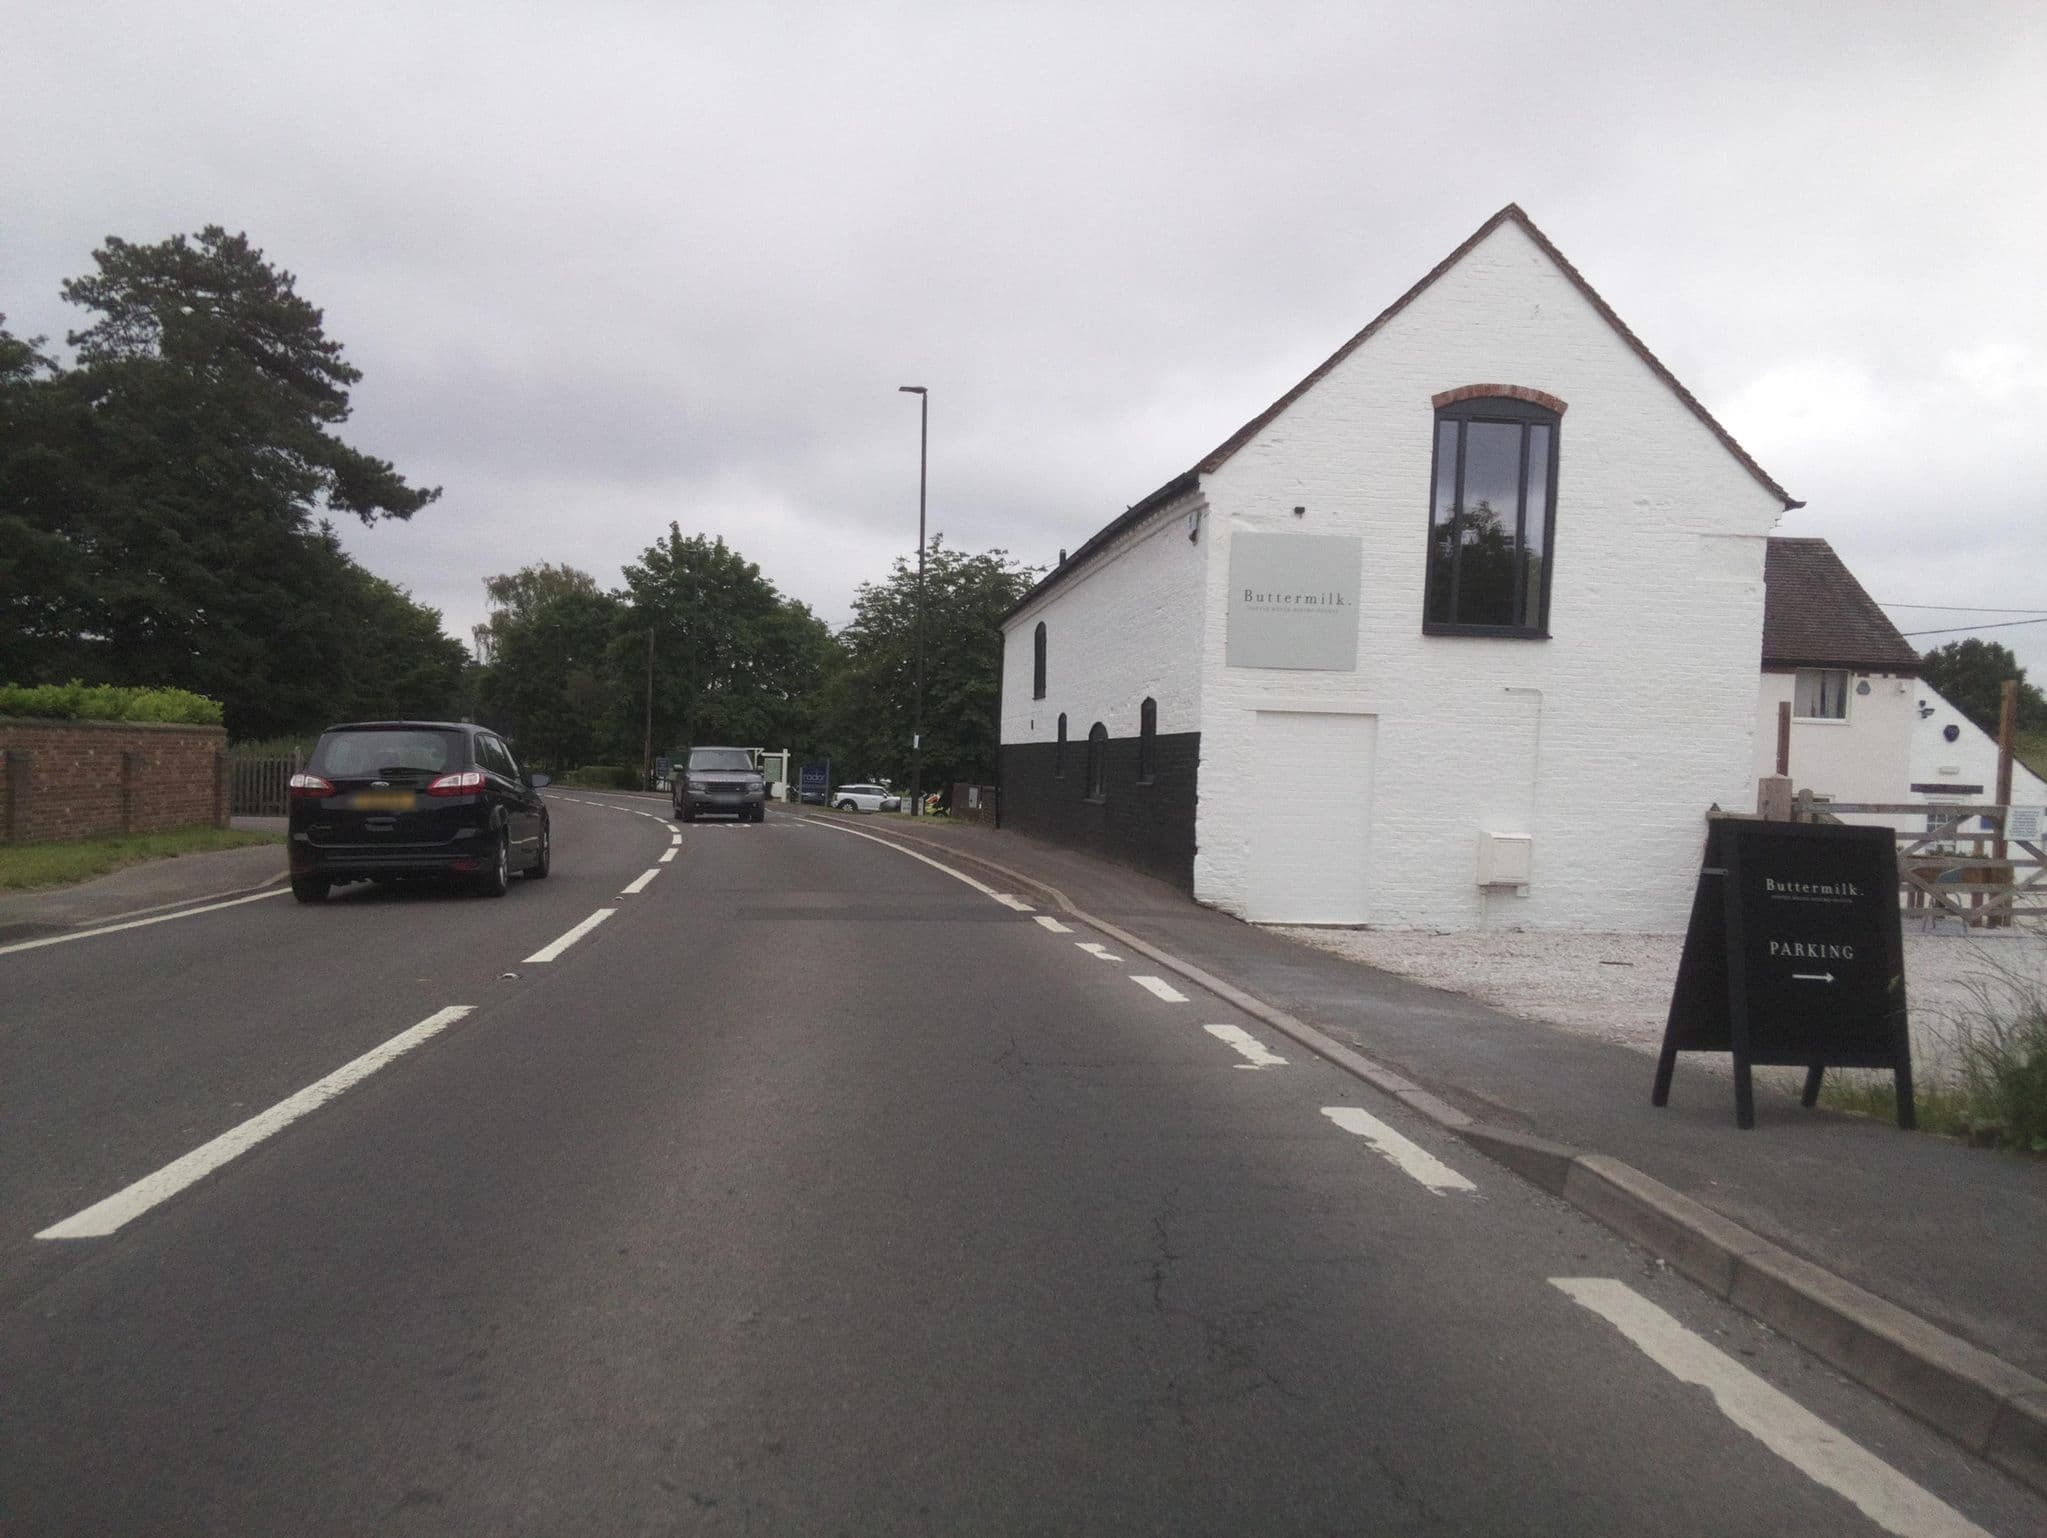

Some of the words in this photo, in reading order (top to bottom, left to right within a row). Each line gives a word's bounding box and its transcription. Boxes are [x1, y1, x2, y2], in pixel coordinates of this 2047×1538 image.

[1244, 589, 1352, 606] Buttermilk.
[1766, 878, 1864, 896] Buttermilk.
[1770, 941, 1854, 960] PARKING
